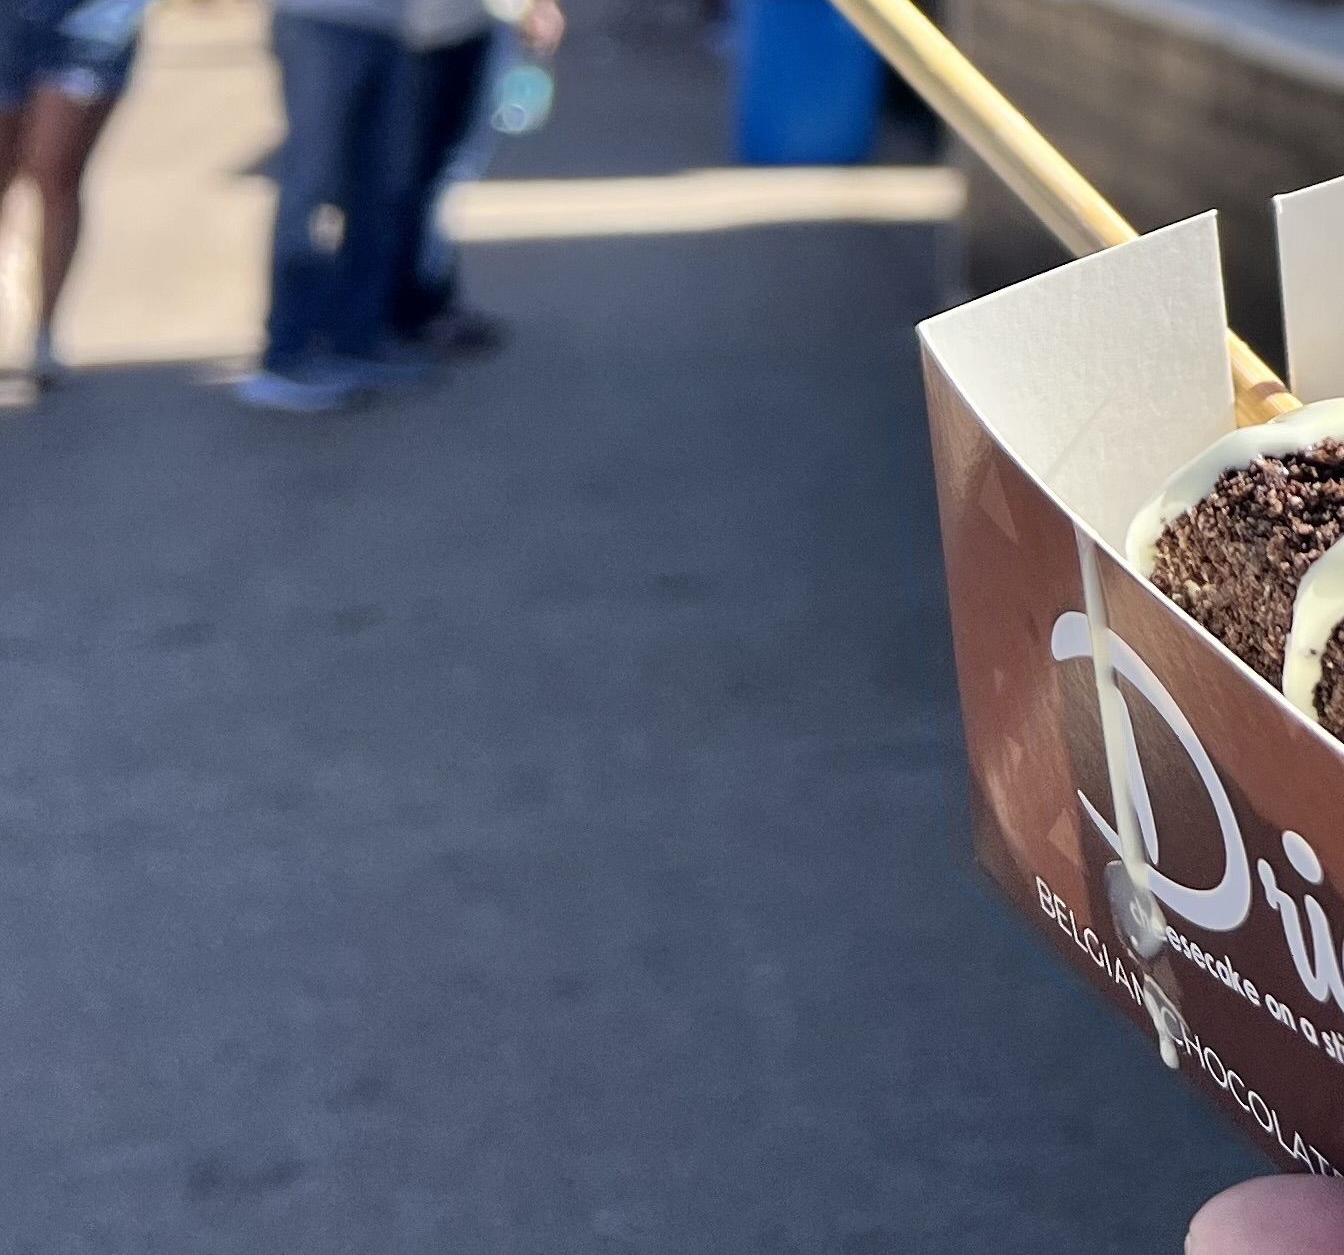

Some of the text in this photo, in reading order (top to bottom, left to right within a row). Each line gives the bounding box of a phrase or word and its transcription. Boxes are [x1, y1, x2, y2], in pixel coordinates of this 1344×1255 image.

[1265, 992, 1298, 1033] on
[1300, 1015, 1320, 1047] a
[1160, 1005, 1344, 1178] CHOCOLAT
